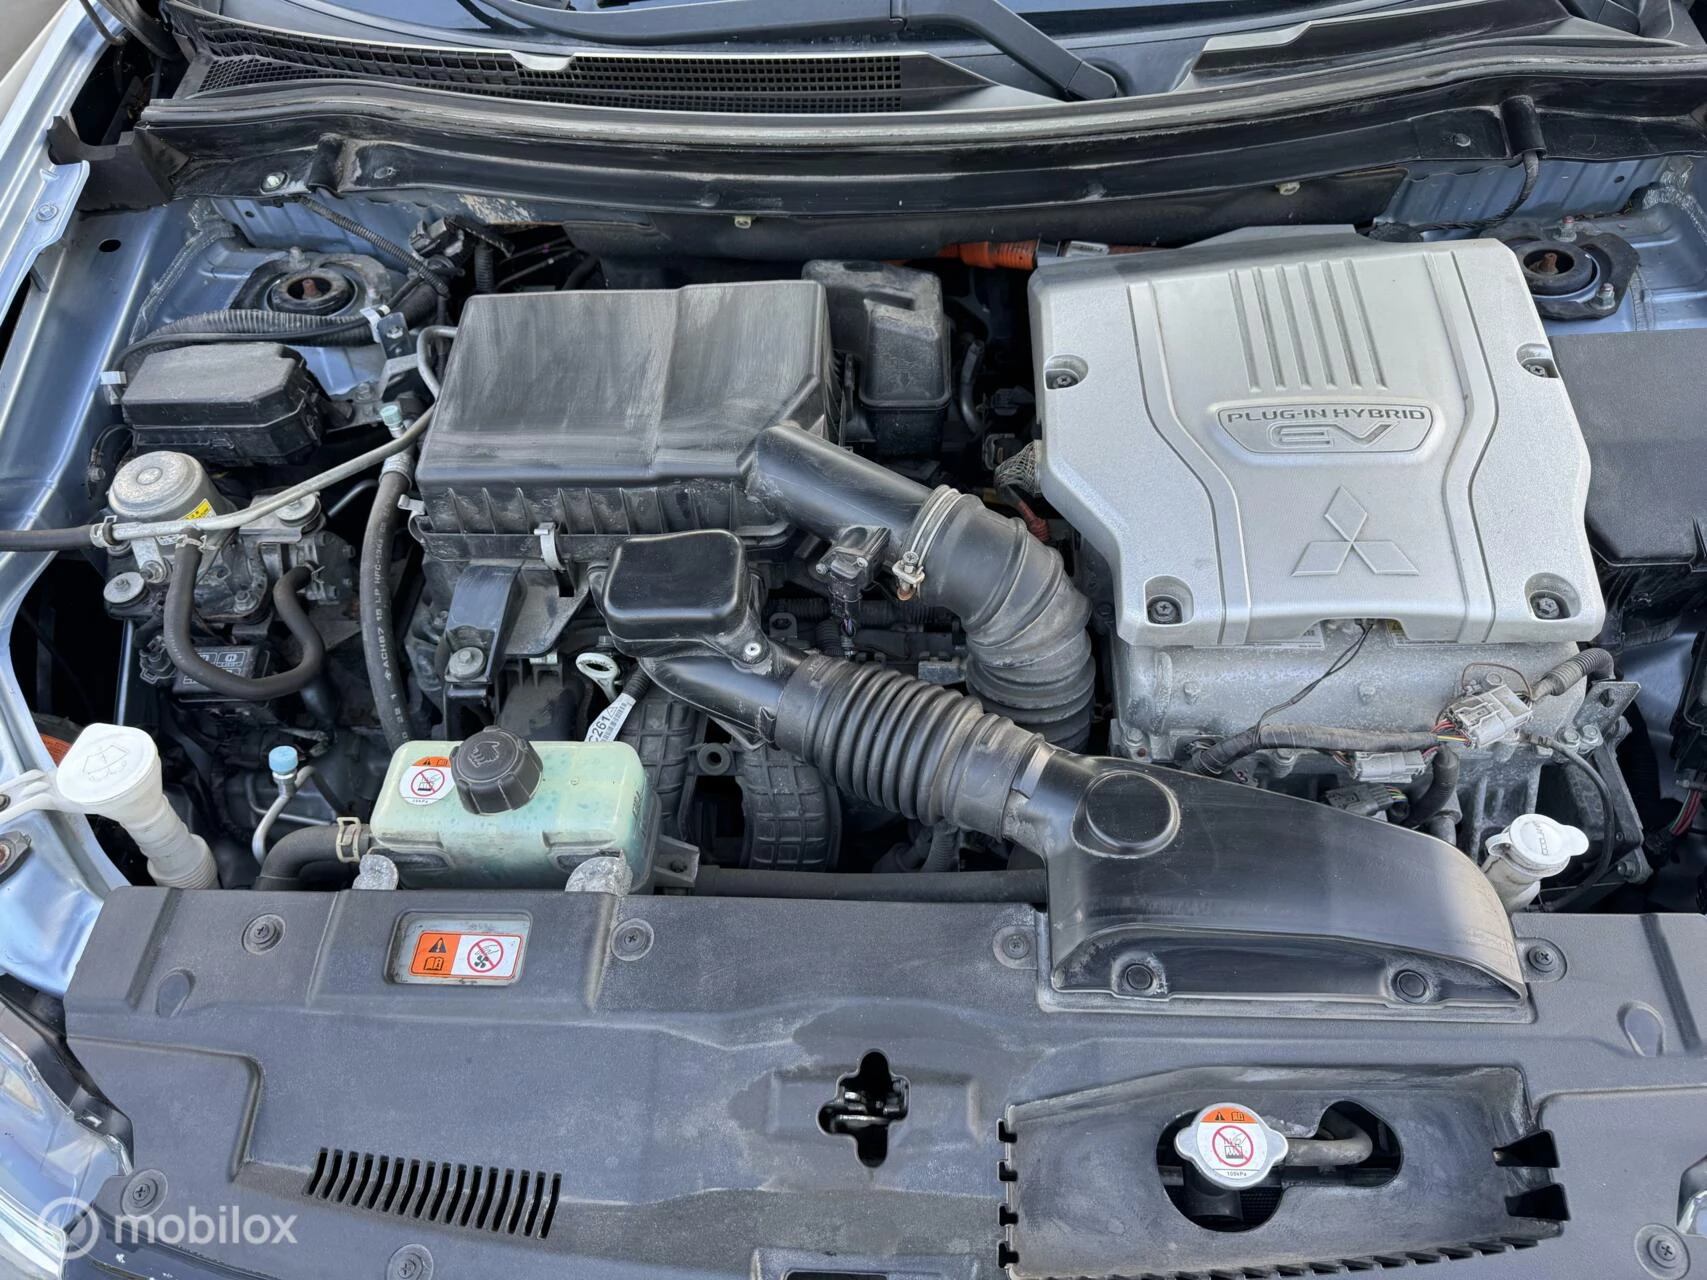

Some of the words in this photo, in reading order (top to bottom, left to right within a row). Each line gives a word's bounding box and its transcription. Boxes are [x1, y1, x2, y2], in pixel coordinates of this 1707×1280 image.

[1227, 408, 1327, 423] PLUG-IN
[1333, 408, 1425, 420] HYBRID
[1266, 421, 1400, 448] EV
